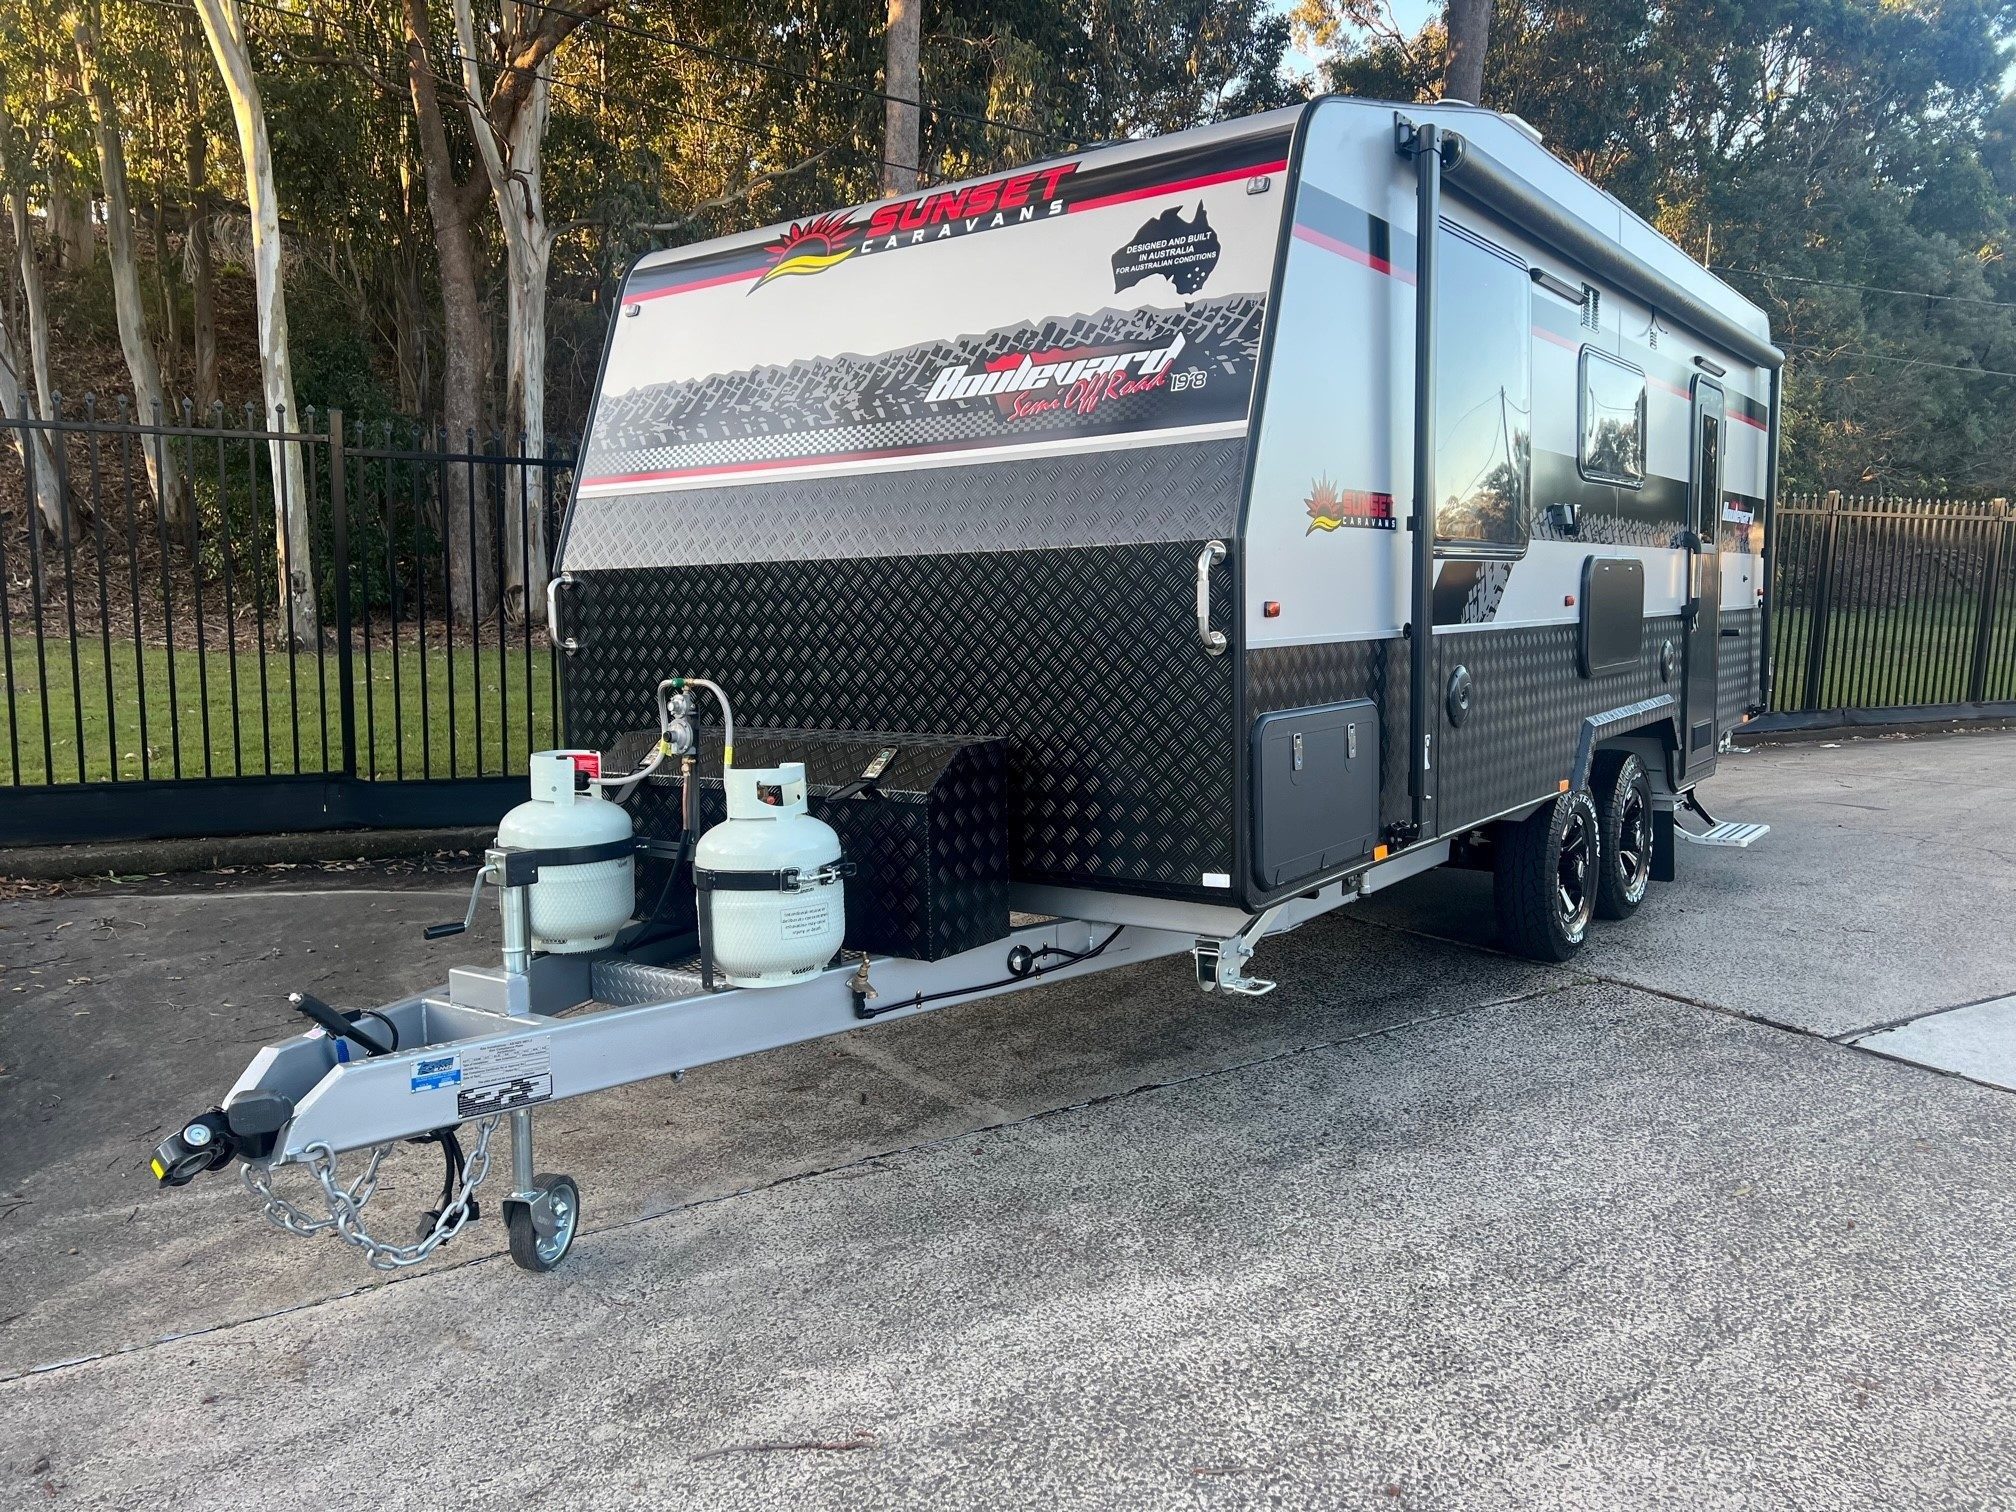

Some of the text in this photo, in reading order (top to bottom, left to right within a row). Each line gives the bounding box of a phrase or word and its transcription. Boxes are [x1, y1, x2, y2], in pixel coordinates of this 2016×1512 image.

[864, 163, 1077, 239] SUNSET
[860, 199, 1064, 253] CARAVANS
[1126, 231, 1212, 254] DESIGNED AND BUILT
[1138, 245, 1195, 262] IN AUSTRALIA
[1115, 251, 1217, 275] FOR AUSTRALIAN CONDITIONS
[924, 331, 1187, 403] Boulevard
[1007, 359, 1174, 421] Semi Off Road
[1342, 489, 1396, 517] SUNSET
[1342, 517, 1396, 528] CARAVANS
